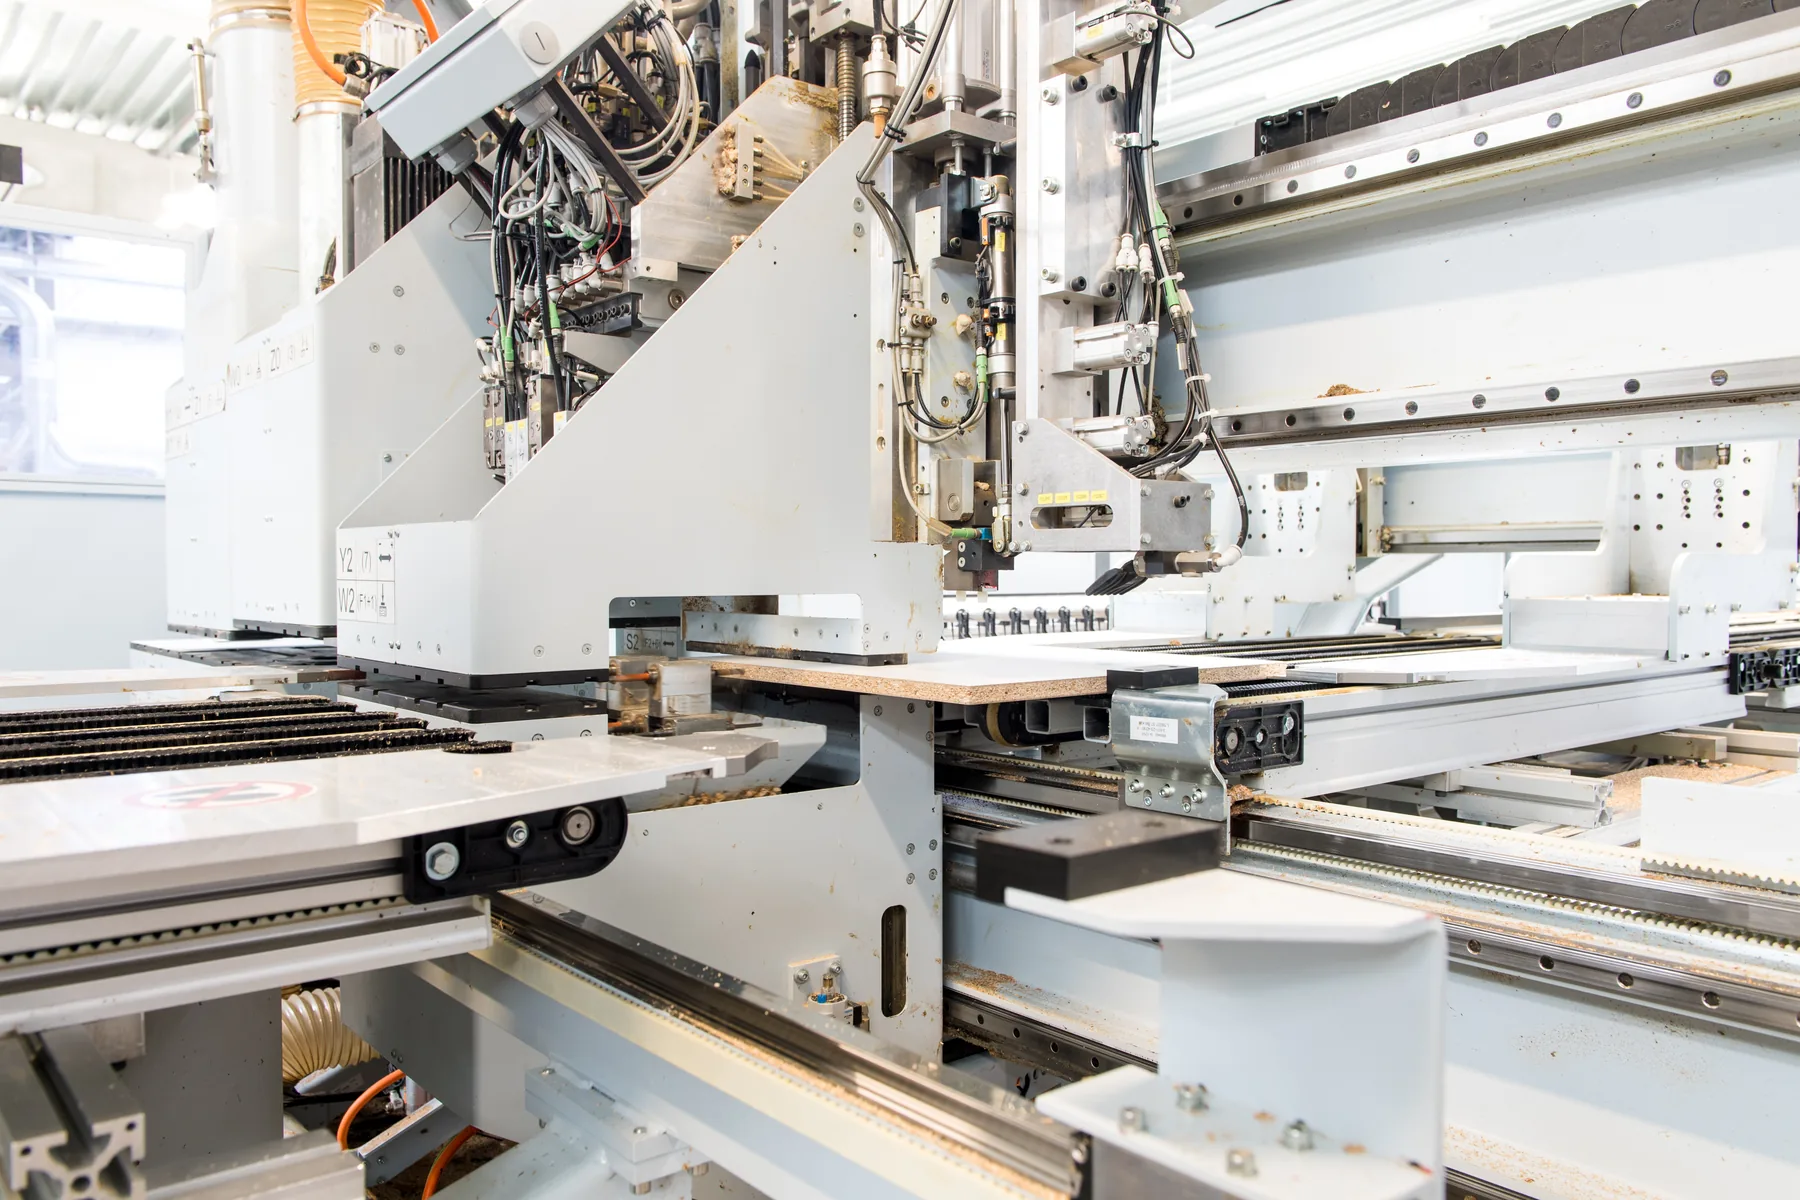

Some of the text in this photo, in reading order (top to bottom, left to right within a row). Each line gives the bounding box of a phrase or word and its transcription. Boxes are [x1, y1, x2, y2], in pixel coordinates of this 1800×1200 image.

[339, 547, 371, 573] Y2 (7)
[338, 587, 355, 613] W2
[626, 633, 639, 650] S2
